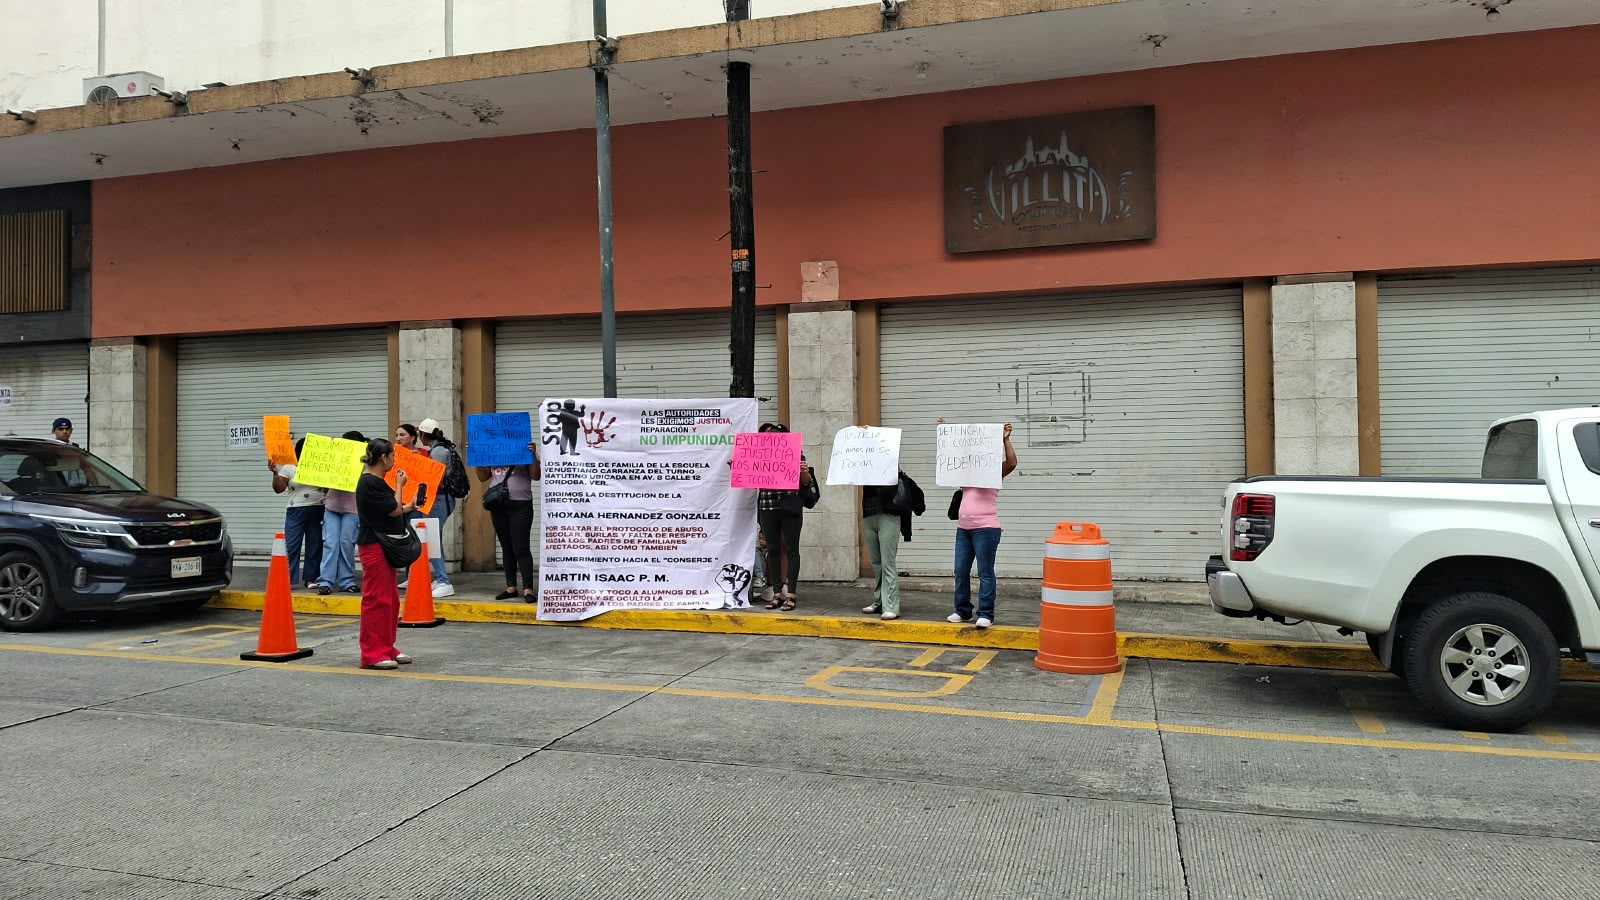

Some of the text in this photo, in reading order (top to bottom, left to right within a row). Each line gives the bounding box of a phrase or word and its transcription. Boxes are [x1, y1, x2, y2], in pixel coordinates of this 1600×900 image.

[985, 165, 1111, 225] VILLITA
[665, 409, 720, 417] AUTORIDADES
[696, 418, 733, 426] JUSTICIA,
[230, 428, 238, 438] SE
[239, 426, 259, 437] RENTA
[639, 434, 735, 445] NO IMPUNIDAD
[740, 447, 794, 461] JUSTICIA
[732, 460, 799, 483] LOS NIÑOS NO
[597, 512, 663, 520] HERNANDEZ
[545, 573, 669, 582] MARTIN ISAAC P. M.
[543, 594, 593, 602] INSTITUCIÓN
